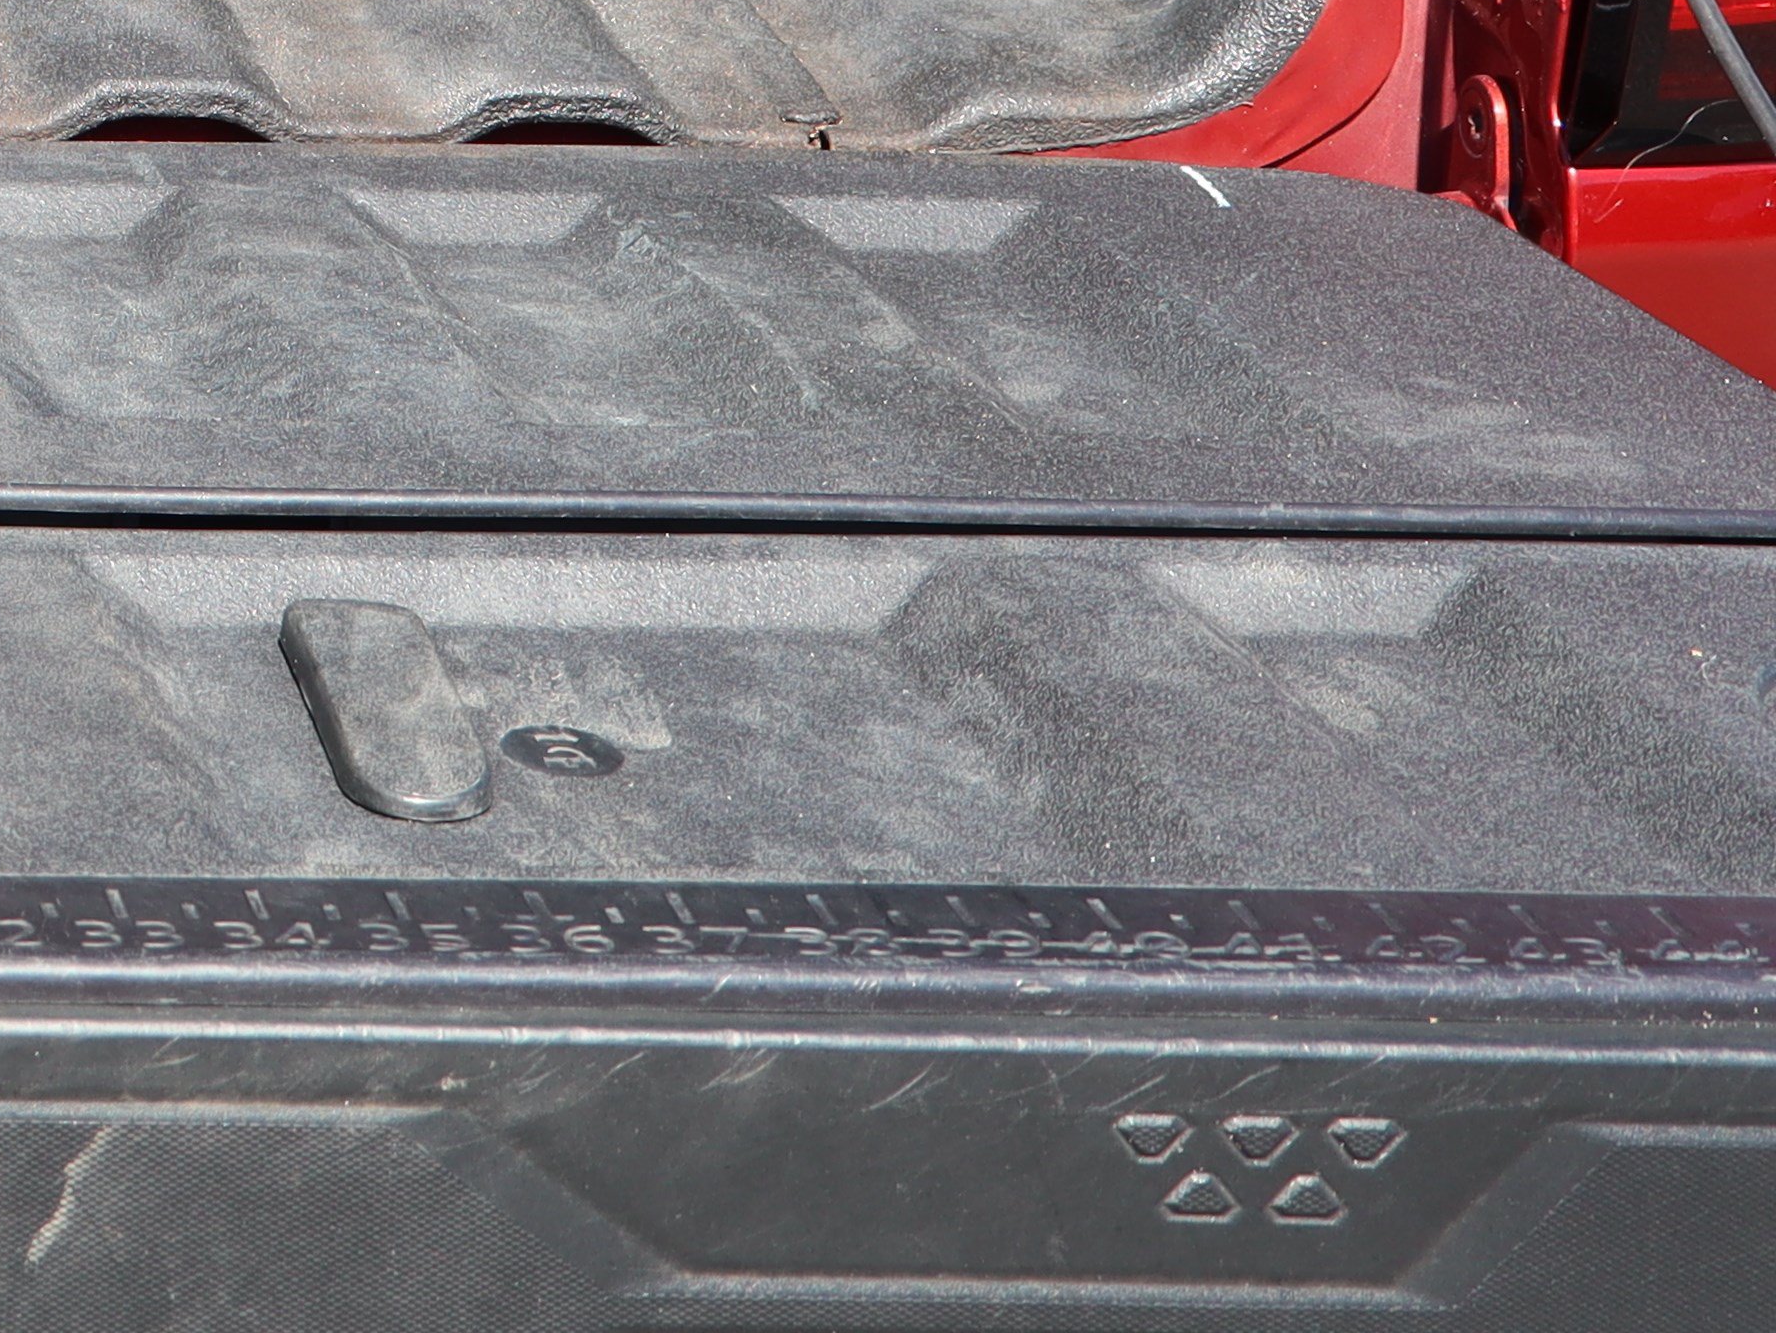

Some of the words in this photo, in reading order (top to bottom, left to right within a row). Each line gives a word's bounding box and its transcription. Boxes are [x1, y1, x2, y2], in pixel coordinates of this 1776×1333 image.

[74, 920, 184, 949] 33
[213, 921, 330, 950] 34
[358, 922, 471, 951] 35
[500, 924, 616, 954] 36
[642, 925, 749, 955] 37
[783, 926, 898, 957] 38
[926, 928, 1043, 958] 39
